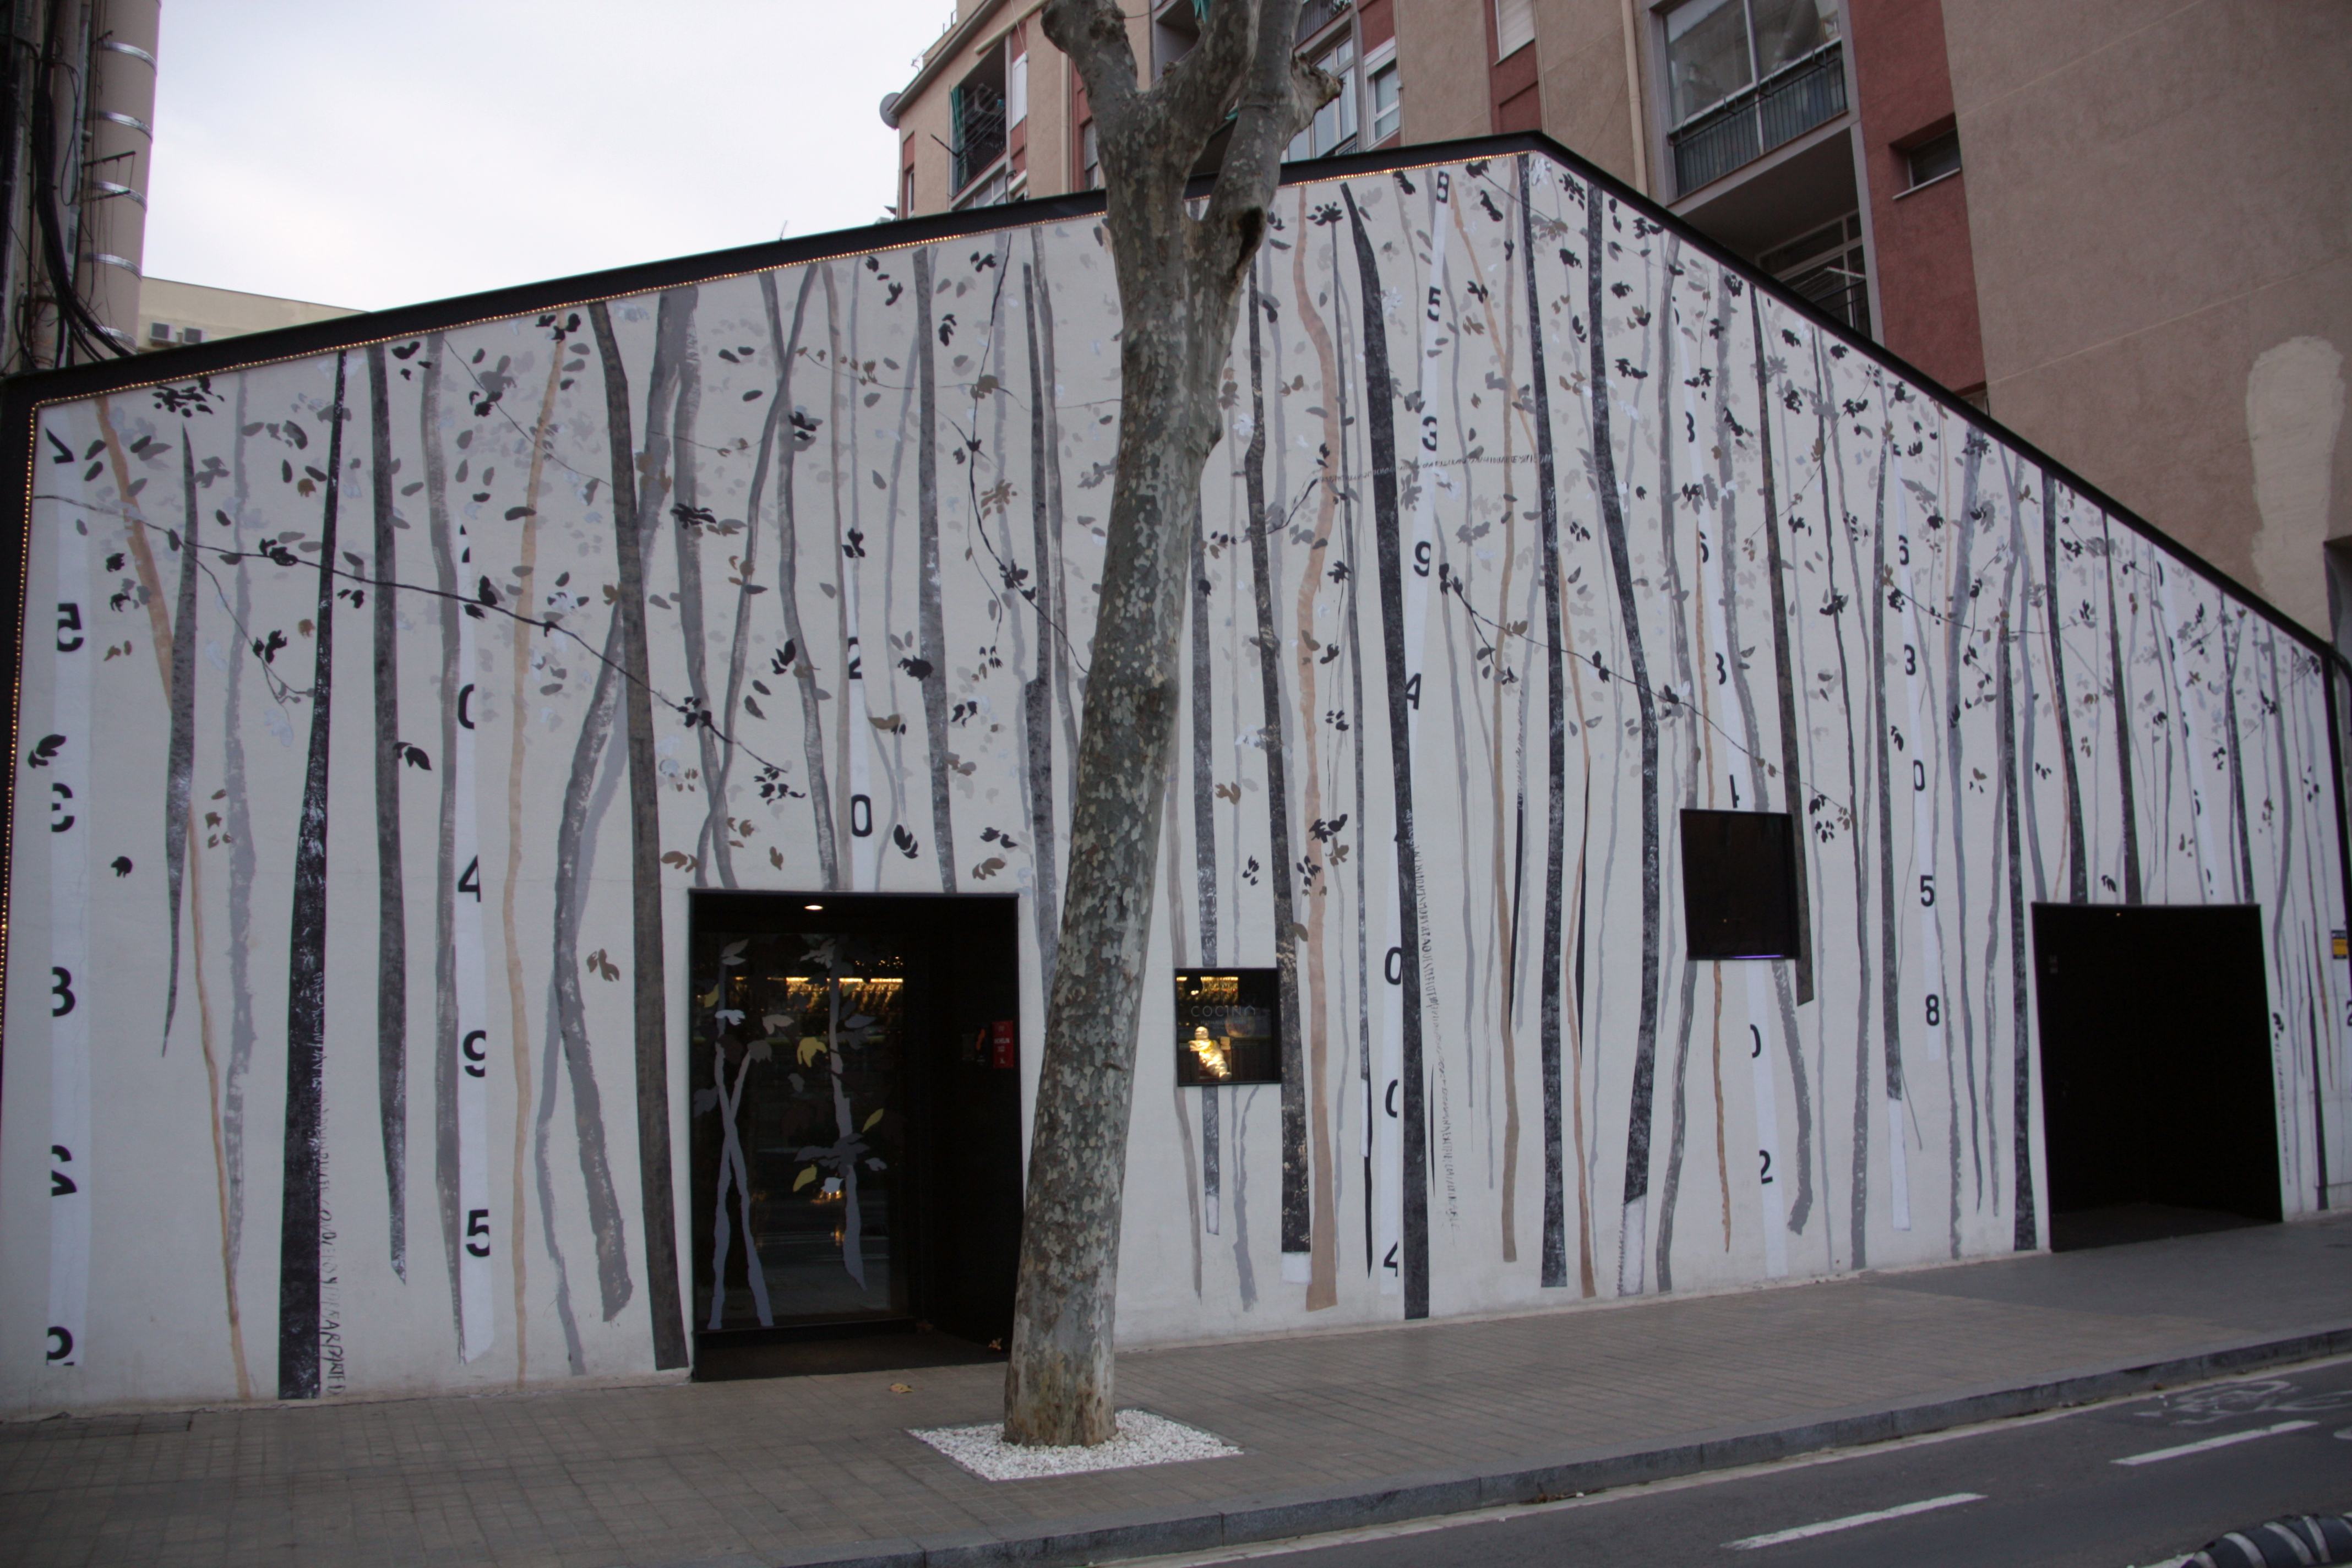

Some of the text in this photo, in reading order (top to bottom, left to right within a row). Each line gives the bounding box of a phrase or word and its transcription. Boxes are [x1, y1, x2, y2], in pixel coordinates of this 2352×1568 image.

[1414, 541, 1431, 576] 9
[458, 856, 481, 902] 4
[1920, 875, 1934, 907] 5
[1191, 1005, 1255, 1017] COCINA
[1926, 994, 1939, 1026] 8
[463, 1030, 486, 1077] 9
[1760, 1150, 1773, 1184] 2
[466, 1210, 489, 1257] 5
